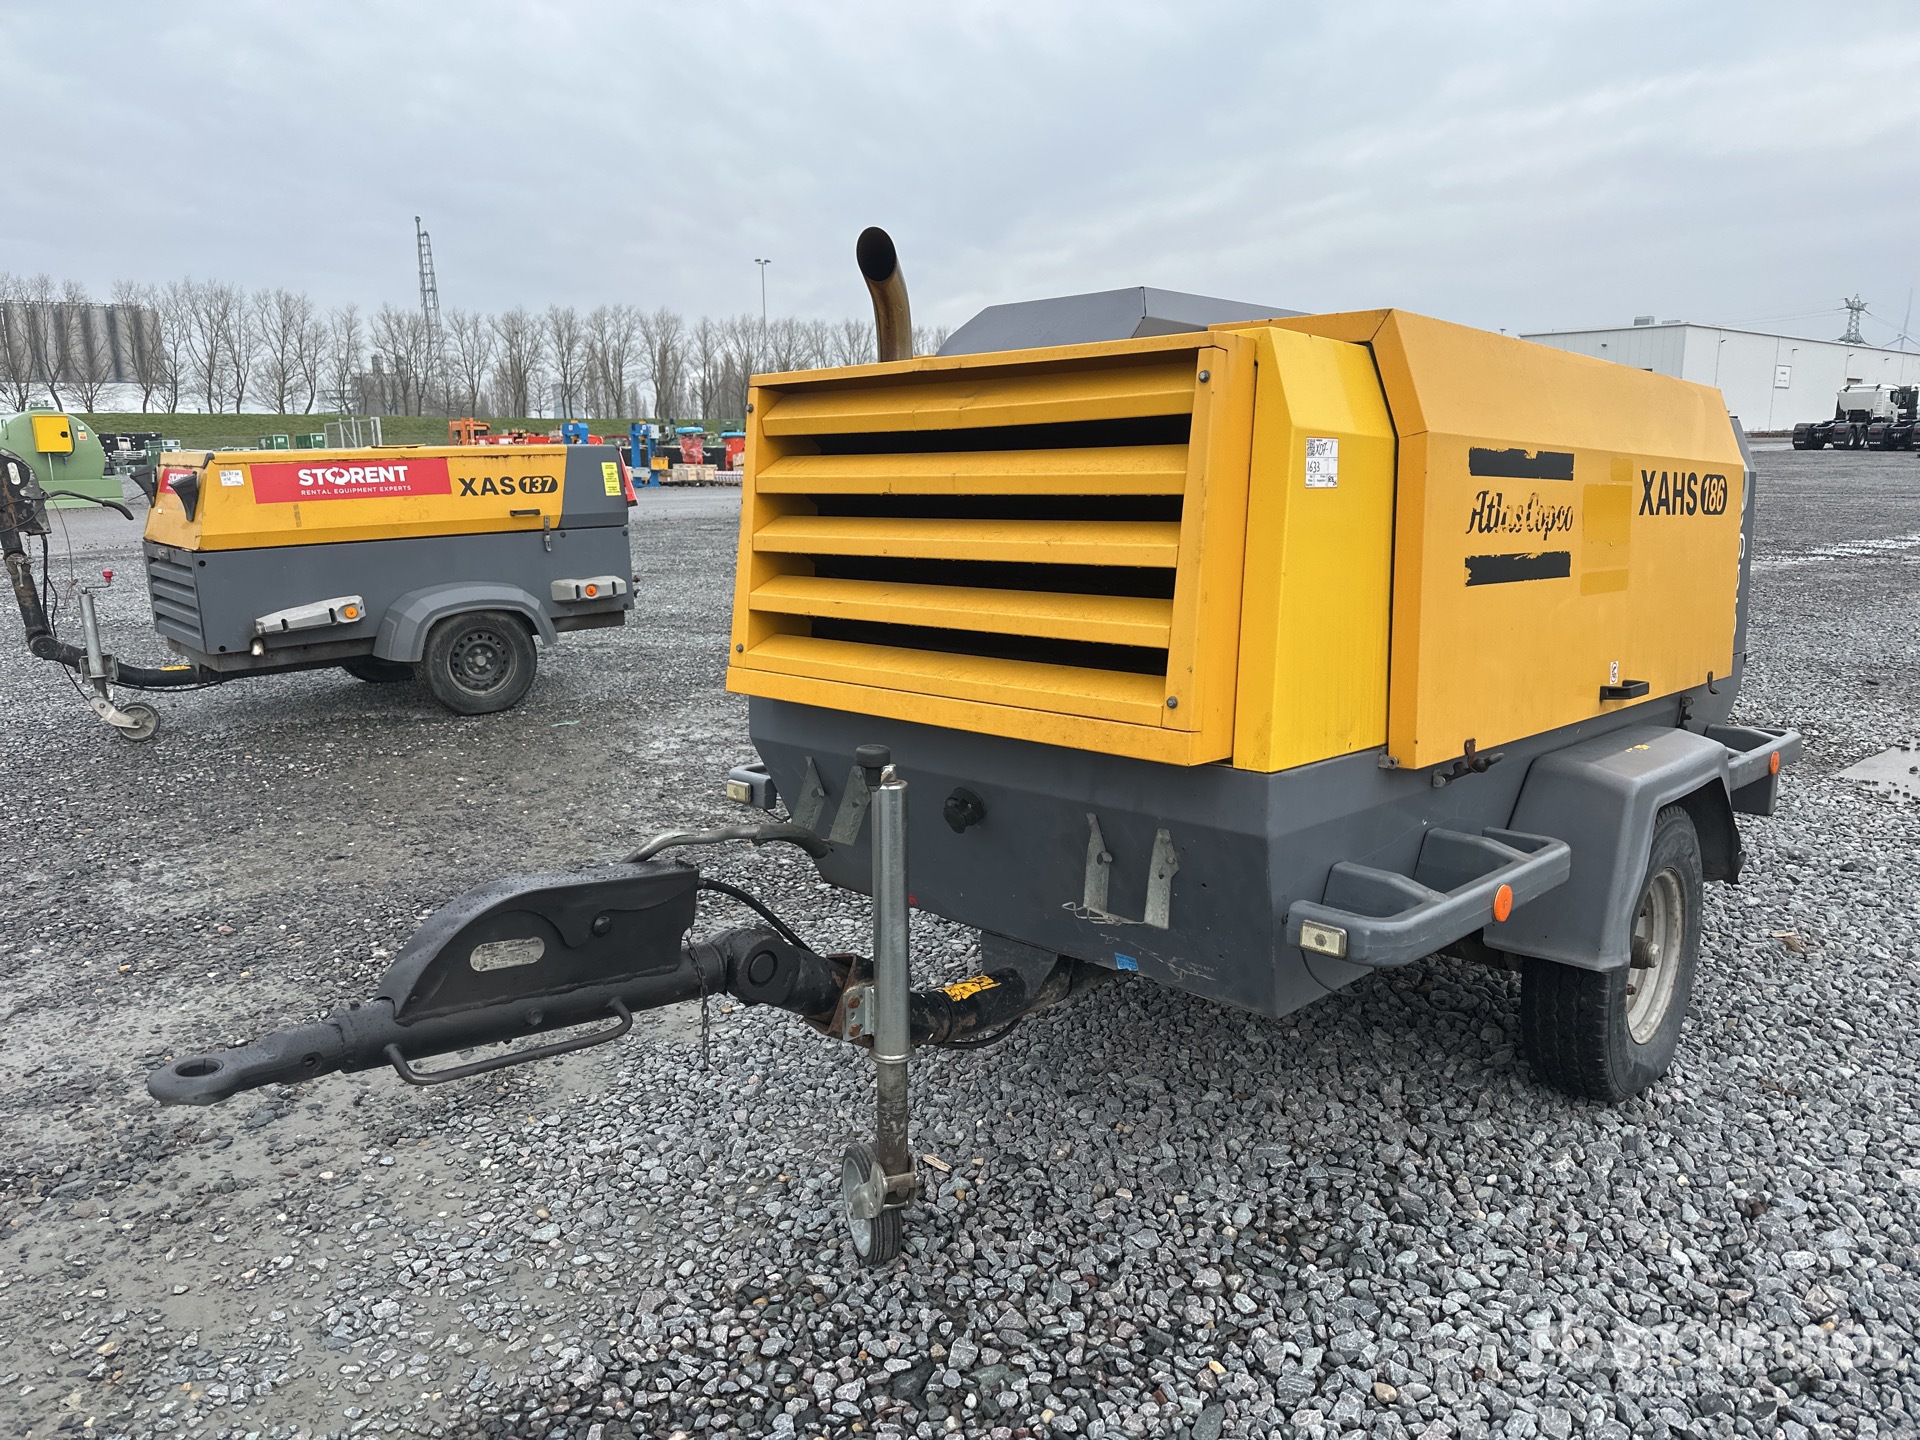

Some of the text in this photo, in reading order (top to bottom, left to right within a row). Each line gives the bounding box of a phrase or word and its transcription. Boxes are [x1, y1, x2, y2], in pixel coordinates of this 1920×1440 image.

[298, 466, 408, 486] STORENT
[334, 486, 377, 494] EQUIPMENT
[458, 476, 553, 497] XAS 137
[1638, 469, 1726, 516] XAHS 186
